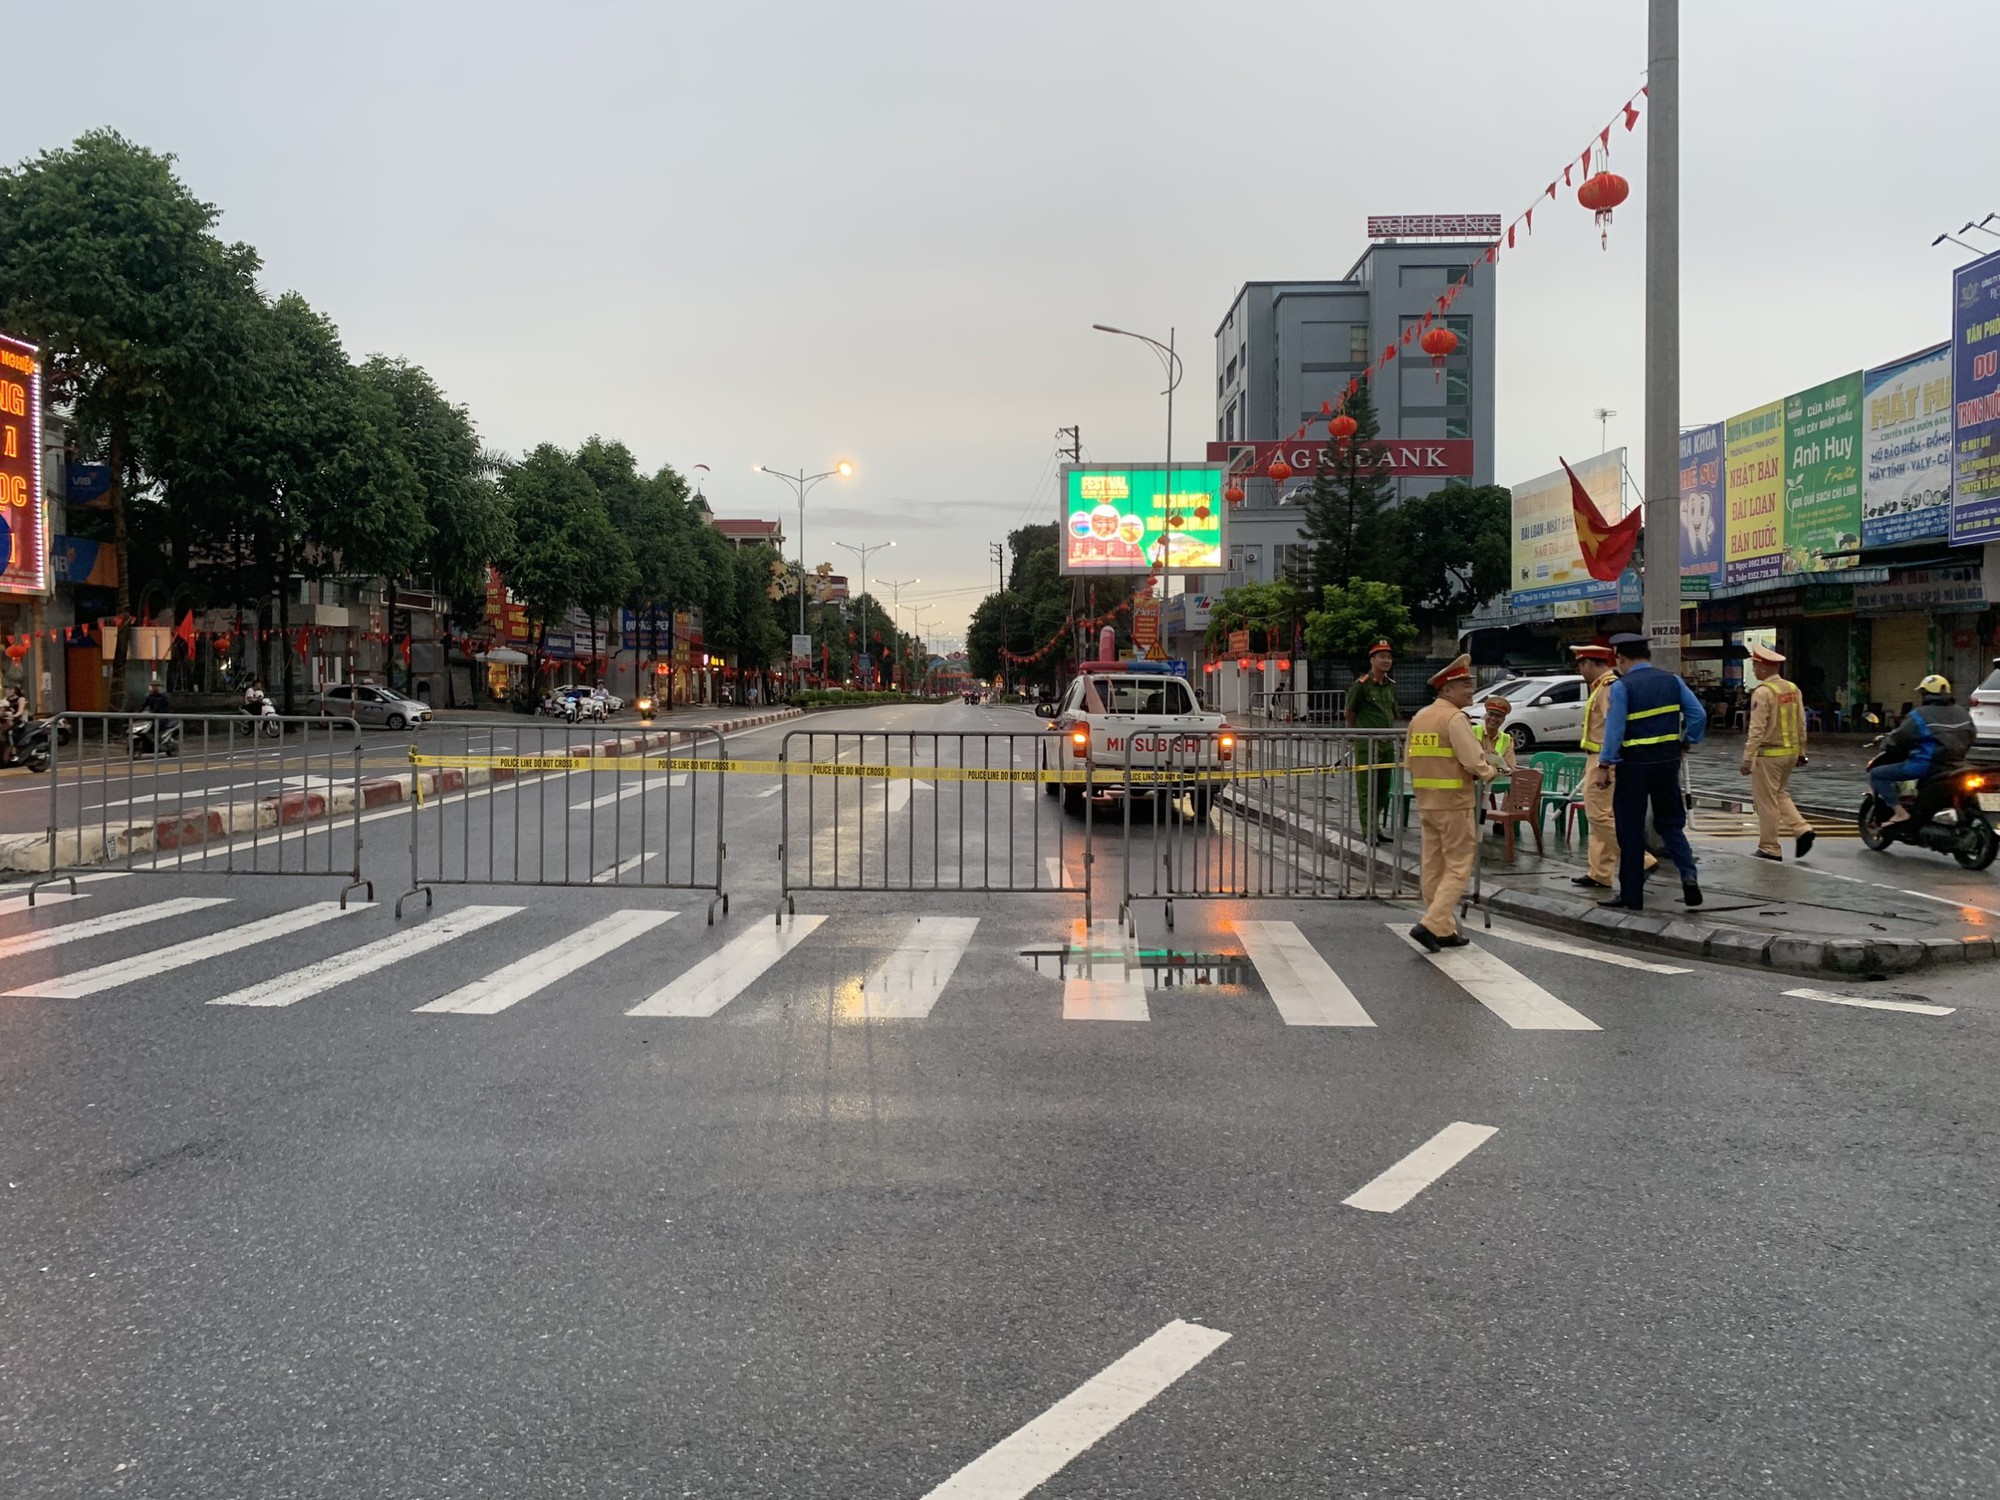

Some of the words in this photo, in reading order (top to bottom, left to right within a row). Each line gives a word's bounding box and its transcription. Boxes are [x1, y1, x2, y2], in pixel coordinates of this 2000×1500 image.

[1373, 217, 1498, 234] AGRIBANK
[1974, 349, 1998, 381] DU
[1957, 396, 1984, 429] TRONG
[1680, 437, 1692, 459] HA
[1694, 429, 1717, 454] KHOA
[1793, 442, 1820, 469] Anh
[1825, 435, 1853, 460] Huy
[1271, 447, 1448, 468] AGRBANK
[1730, 462, 1755, 489] NHẬT
[1758, 454, 1779, 481] BẢN
[72, 477, 92, 486] VIB
[1732, 497, 1747, 521] ĐÀI
[1749, 492, 1775, 517] LOAN
[1731, 530, 1750, 554] HÀN
[1752, 520, 1777, 550] QUỐC
[52, 555, 67, 572] IB
[1652, 626, 1680, 636] VN2.CO
[1107, 737, 1201, 753] MISUBSHI
[500, 758, 519, 768] POLICE
[520, 758, 533, 768] LINE
[534, 758, 542, 768] DO
[543, 758, 554, 768] NOT
[555, 758, 573, 768] CROSS
[657, 760, 677, 769] POLCE
[678, 760, 690, 769] LINE
[690, 761, 699, 770] DO
[700, 761, 711, 770] NOT
[711, 761, 729, 771] CROSS
[813, 765, 832, 775] POLICE
[832, 766, 845, 775] LINE
[846, 766, 854, 775] DO
[855, 767, 865, 776] NOT
[866, 767, 884, 776] CROSS
[968, 770, 987, 779] POLICE
[987, 771, 1000, 780] LINE
[1001, 771, 1009, 780] DO
[1010, 771, 1020, 780] NOT
[1021, 771, 1037, 780] CROS
[1122, 773, 1141, 781] PLICE
